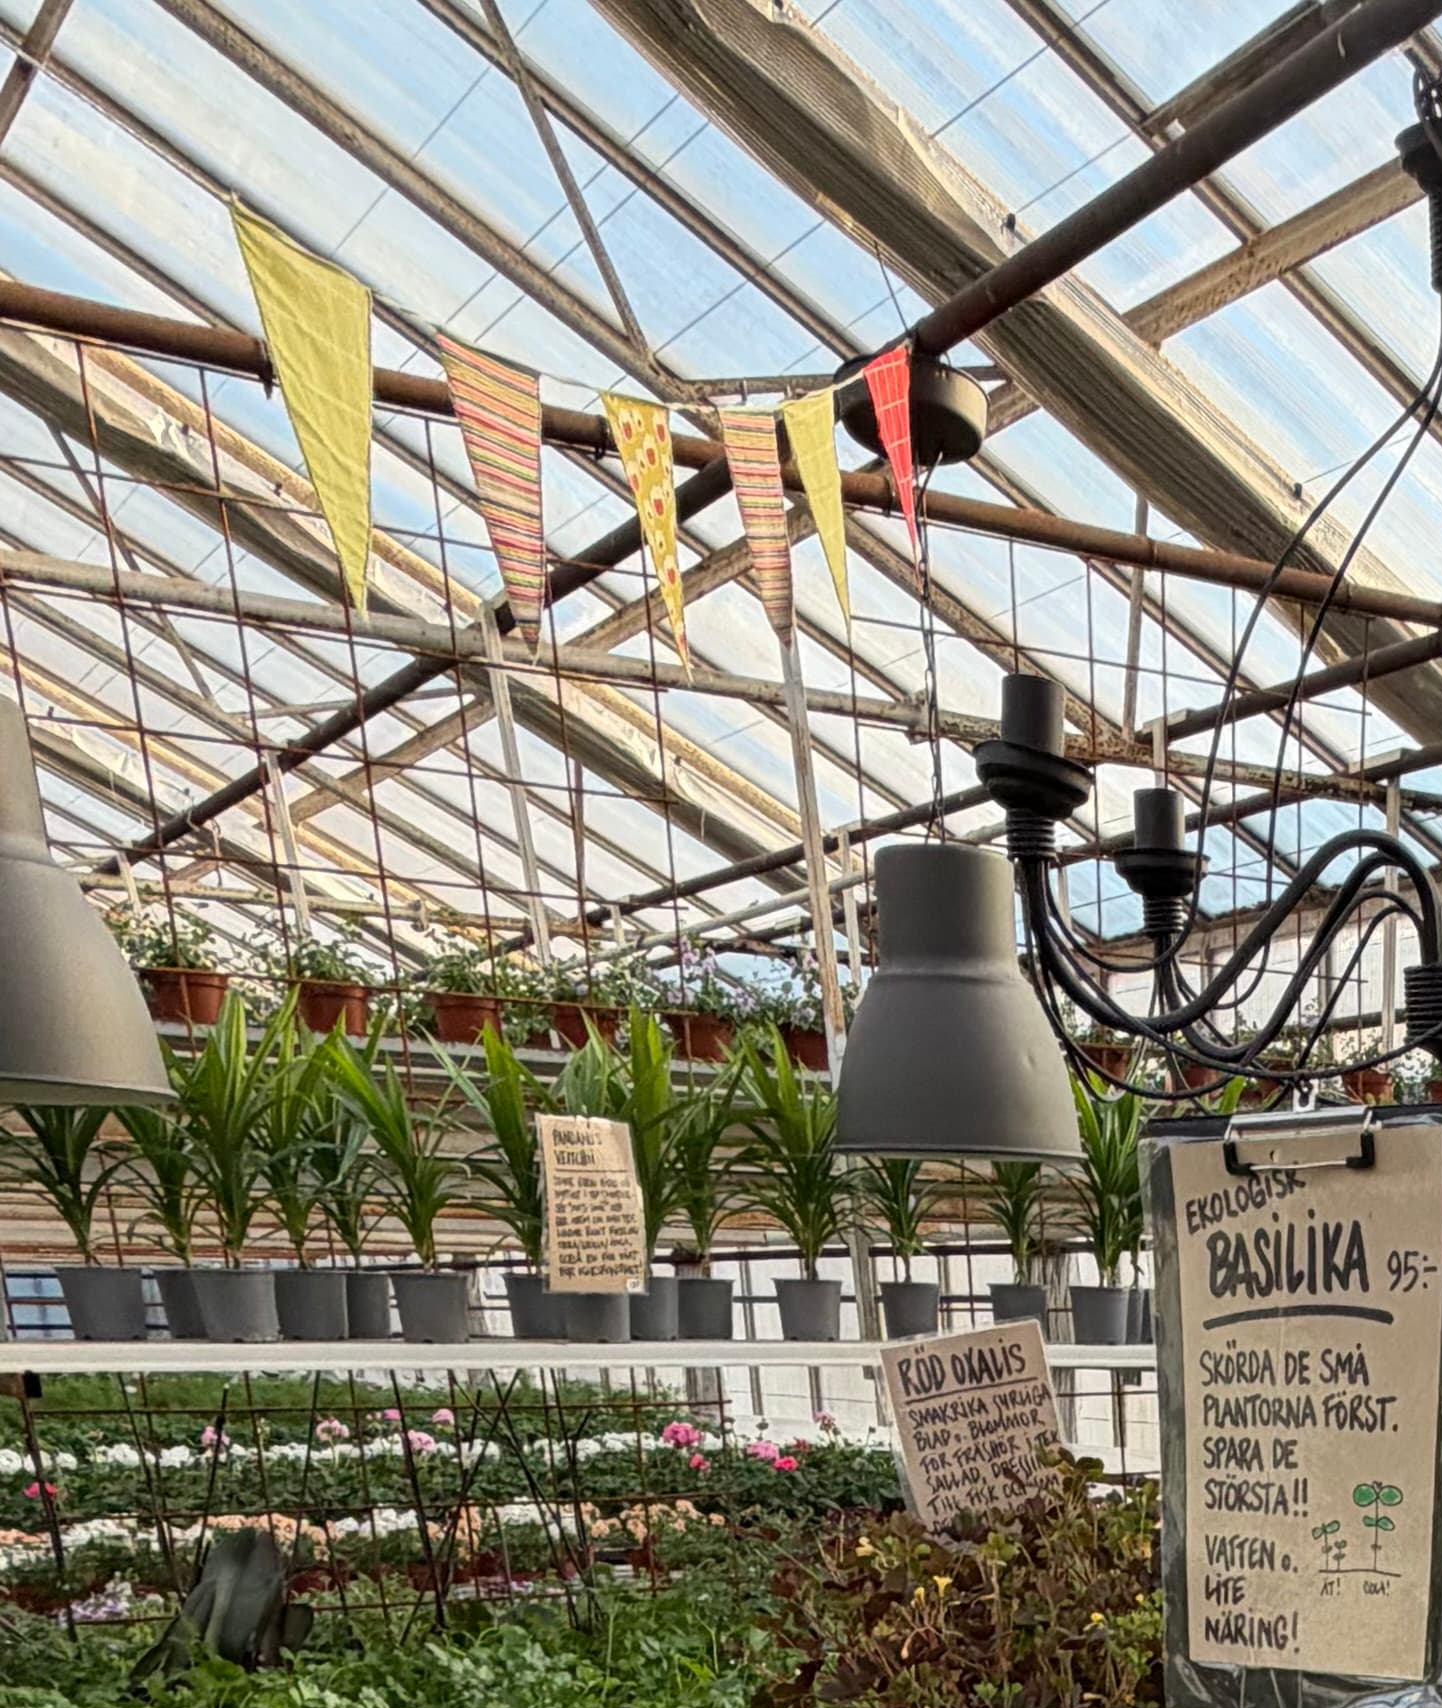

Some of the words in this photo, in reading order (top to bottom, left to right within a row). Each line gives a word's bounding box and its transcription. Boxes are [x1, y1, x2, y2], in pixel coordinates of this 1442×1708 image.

[1185, 1162, 1307, 1236] EKOLOGISK
[1205, 1211, 1370, 1299] BASILIKA
[897, 1343, 946, 1397] RÖD
[950, 1337, 1026, 1386] OXALIS
[1200, 1338, 1276, 1387] SKÖRDA
[1283, 1349, 1310, 1386] DE
[1319, 1342, 1369, 1387] SMÅ
[1203, 1392, 1317, 1429] PLANTORNA
[1323, 1389, 1399, 1433] FÖRST.
[912, 1428, 951, 1452] BLAD
[1202, 1435, 1264, 1472] SPARA
[1272, 1438, 1299, 1470] DE
[1204, 1472, 1310, 1518] STÖRSTA!!
[1204, 1533, 1276, 1573] VATTEN
[1204, 1572, 1247, 1608] LITE
[1204, 1606, 1301, 1654] NÄRING!
